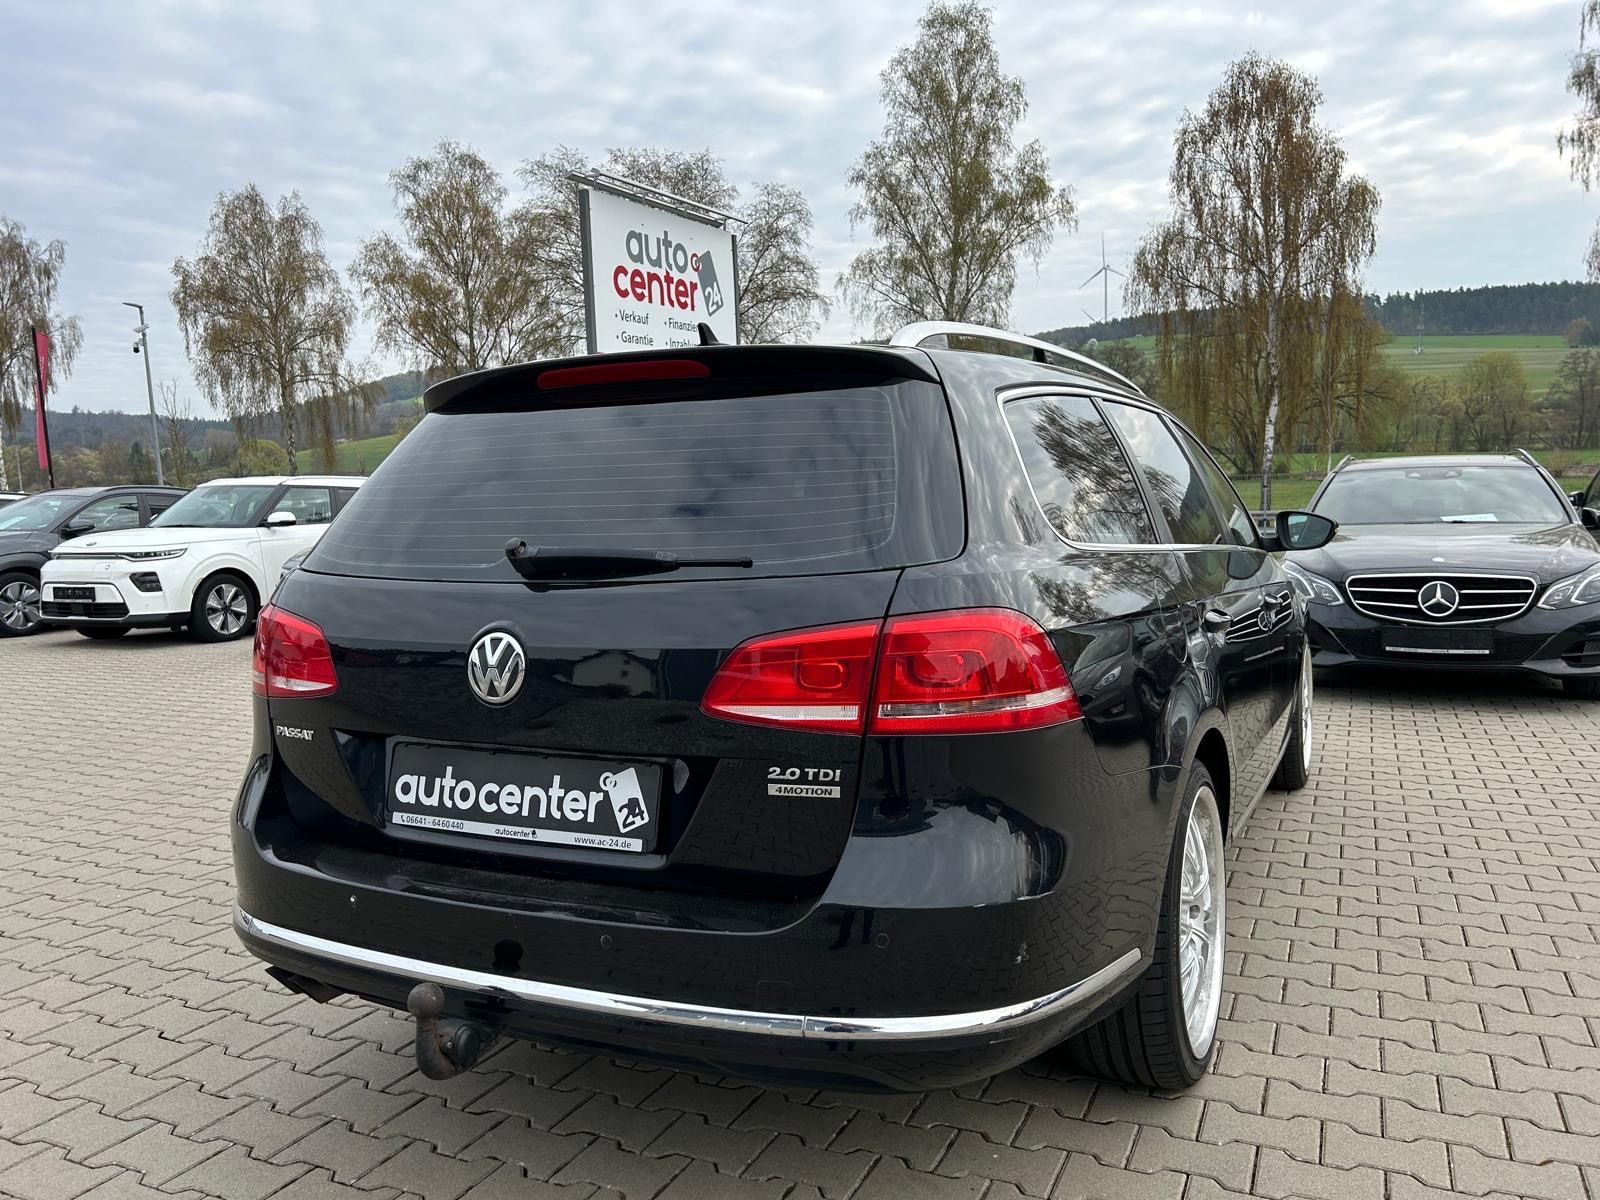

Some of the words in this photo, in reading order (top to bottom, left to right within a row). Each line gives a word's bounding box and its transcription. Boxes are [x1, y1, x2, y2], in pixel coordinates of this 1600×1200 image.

[625, 230, 689, 274] auto
[613, 265, 698, 311] center
[704, 281, 721, 314] 24
[619, 309, 649, 325] Verkauf
[621, 331, 654, 346] Garantie
[669, 337, 698, 348] Inzahl
[276, 725, 314, 741] PASSAT
[767, 766, 801, 780] 2.0
[804, 767, 841, 781] TDI
[394, 765, 604, 824] autocenter
[618, 796, 646, 830] 24
[775, 786, 833, 796] 4MOTION
[406, 815, 426, 825] 06641
[495, 827, 530, 838] autocenter
[574, 836, 632, 849] www.ac-24.de
